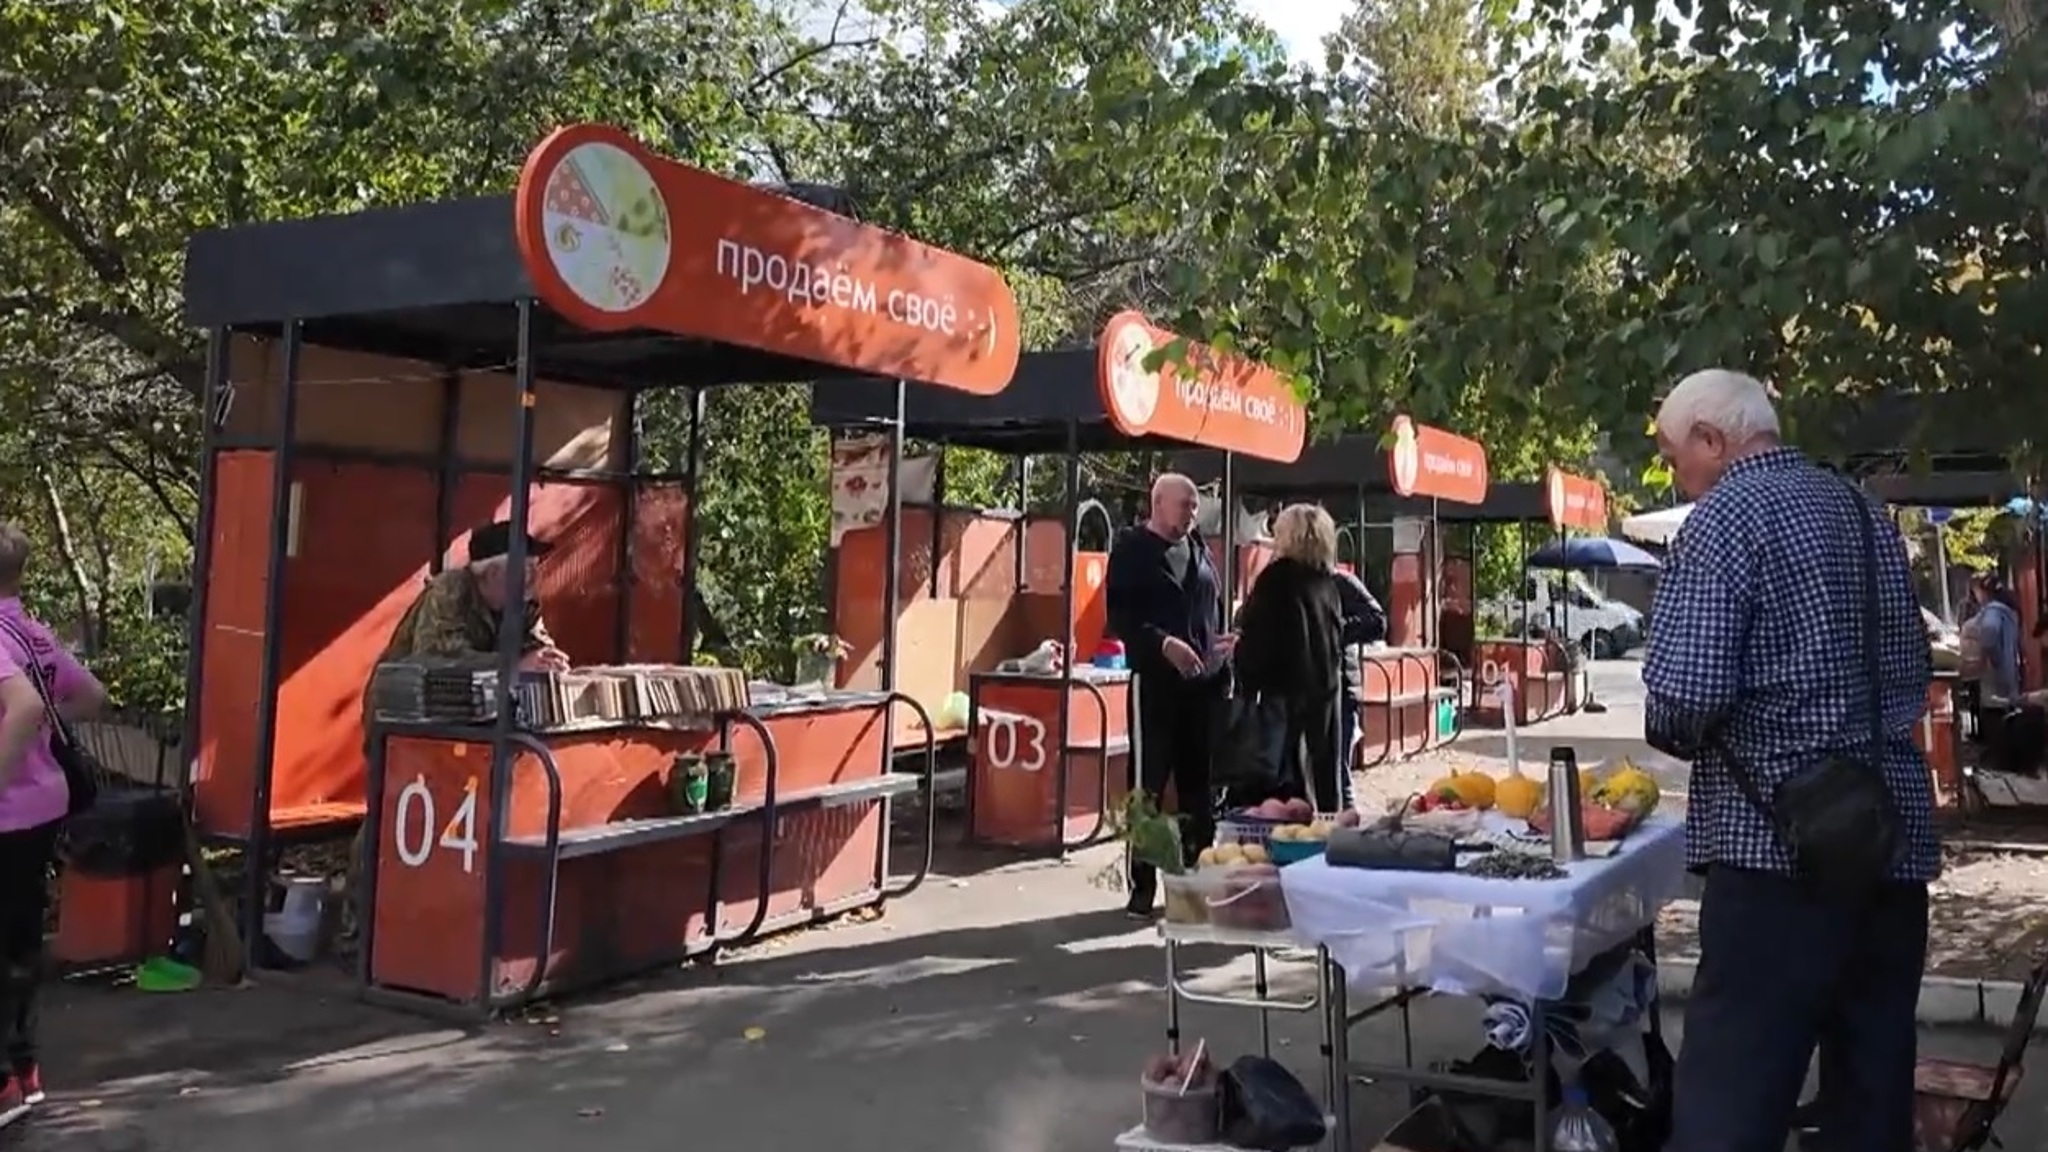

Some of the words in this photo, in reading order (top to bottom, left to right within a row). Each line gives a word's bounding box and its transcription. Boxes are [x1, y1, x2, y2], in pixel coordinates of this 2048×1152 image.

[717, 239, 876, 315] продаём
[888, 289, 957, 334] своё
[1482, 660, 1511, 685] 01
[987, 714, 1046, 771] 03
[396, 774, 478, 873] 04
